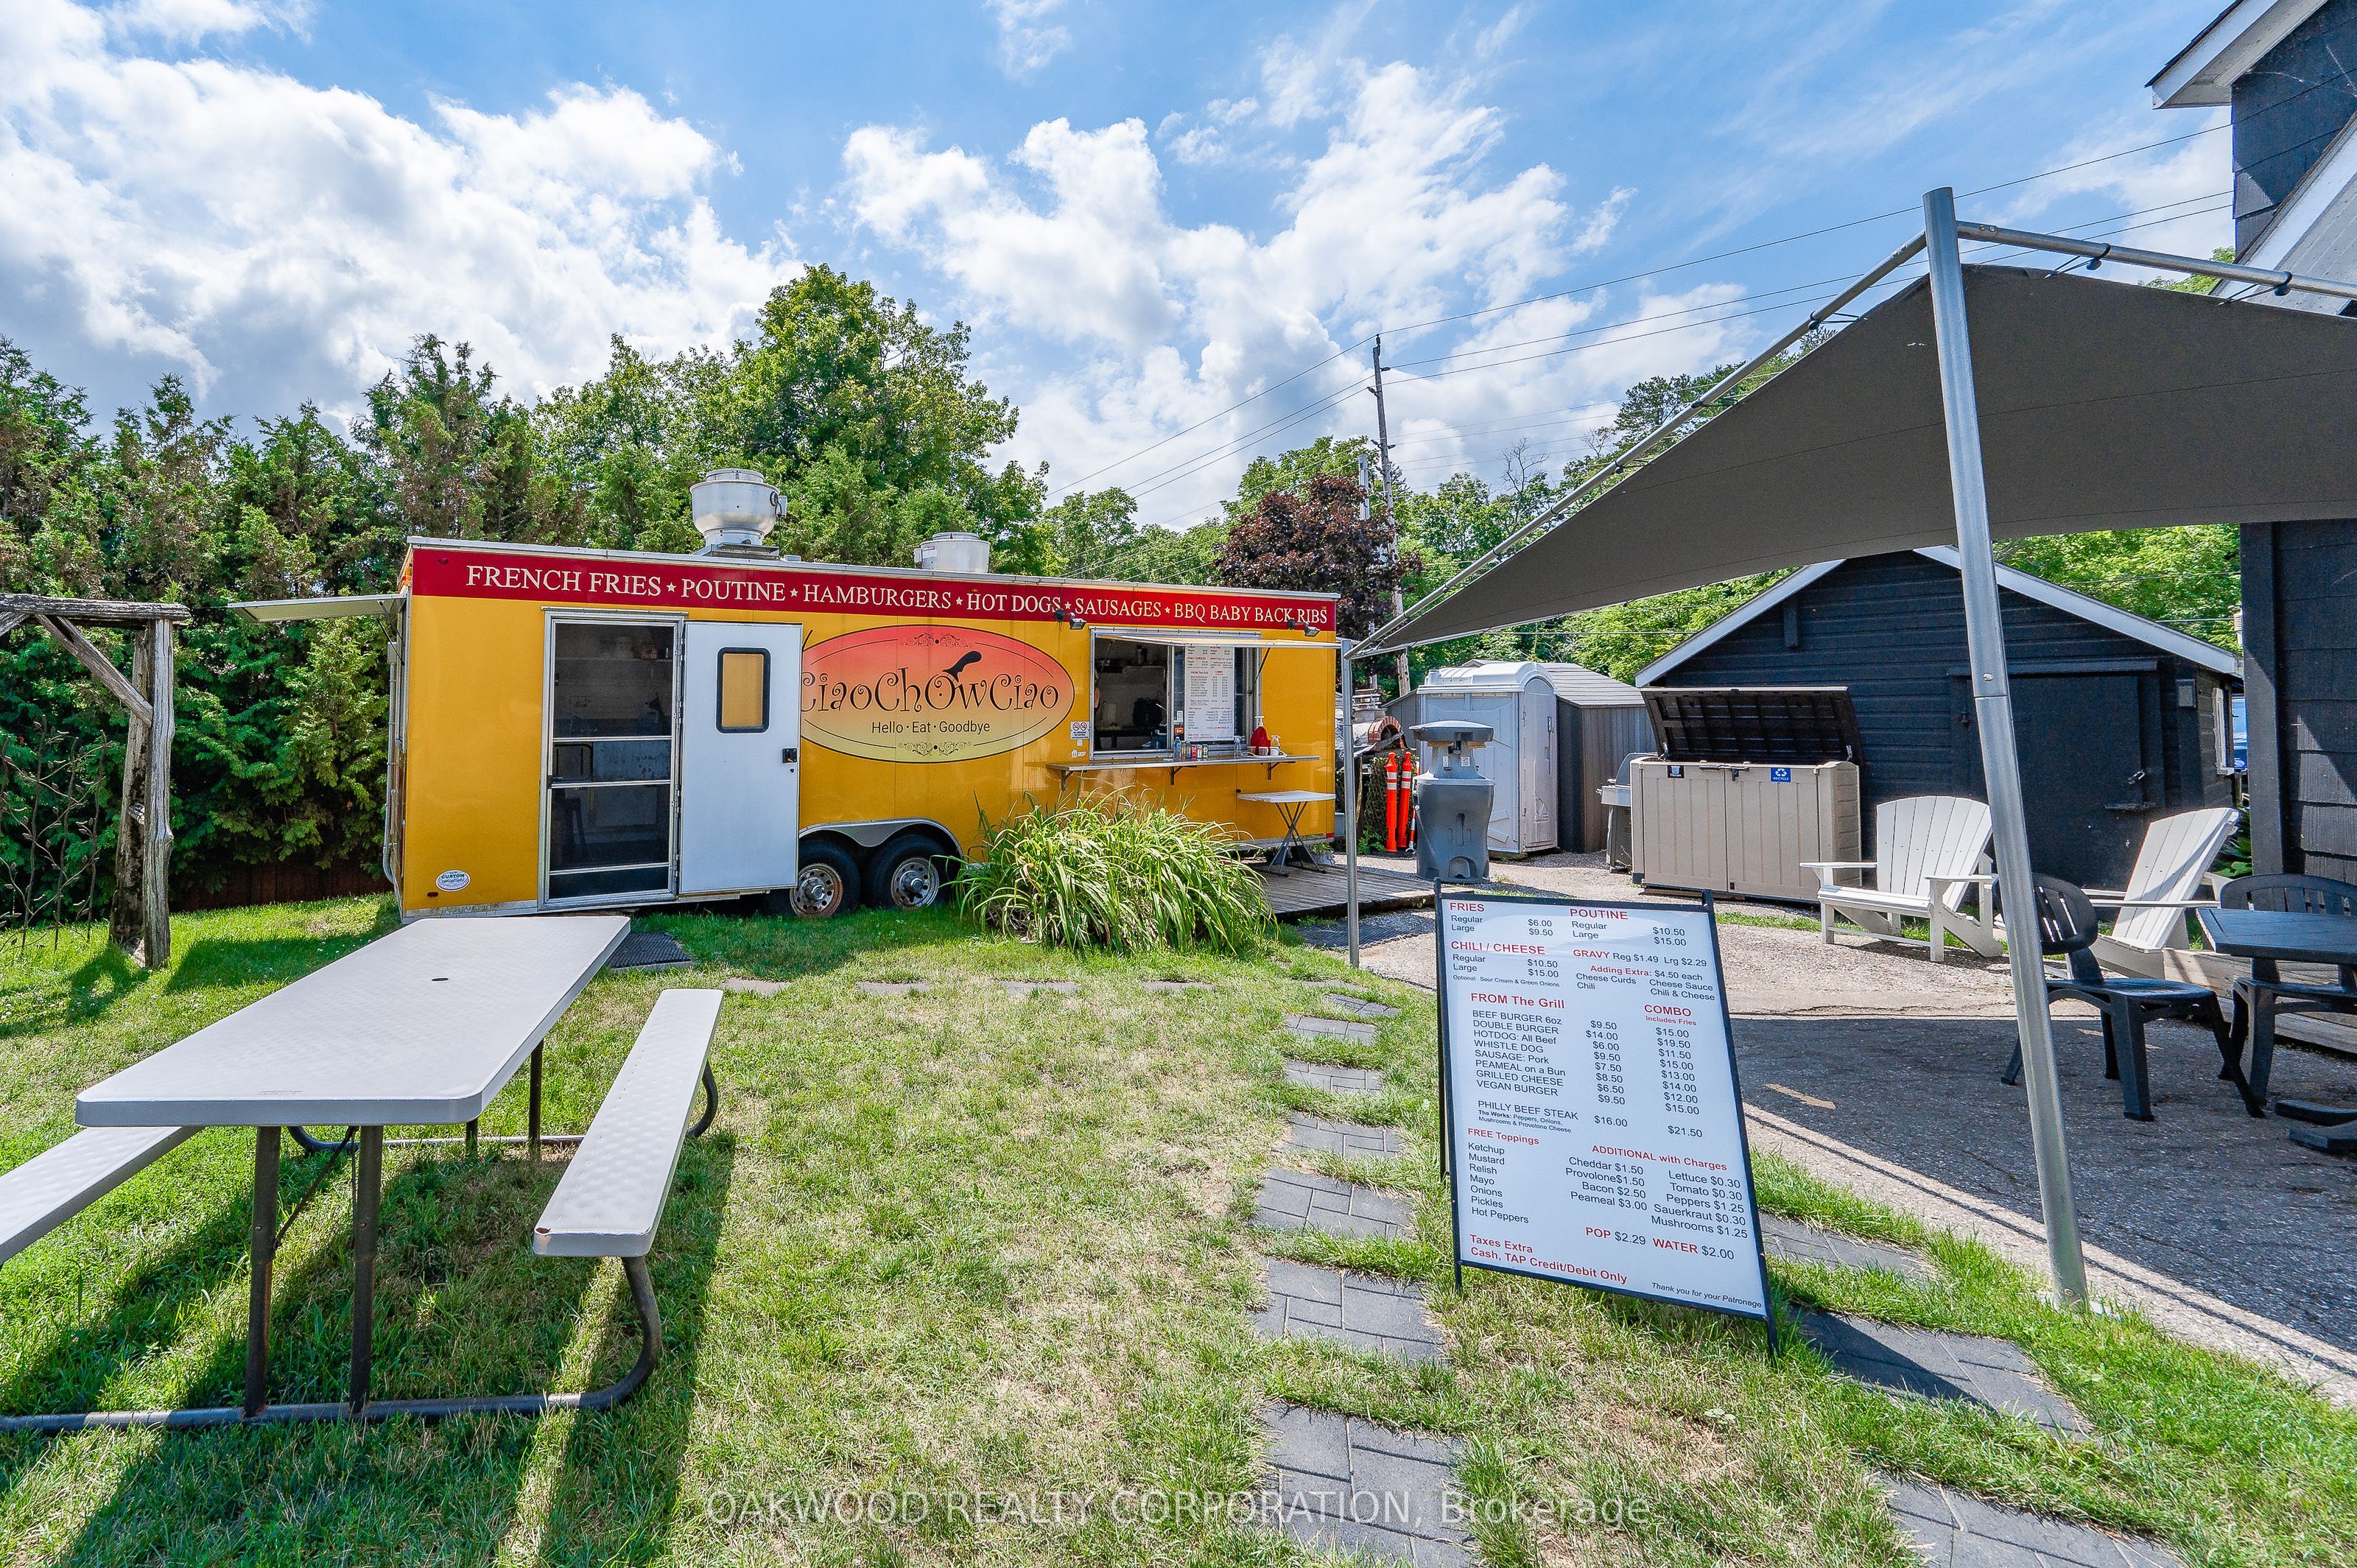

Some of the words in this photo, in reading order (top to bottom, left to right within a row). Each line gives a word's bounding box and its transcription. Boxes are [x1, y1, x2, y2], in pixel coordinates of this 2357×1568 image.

[466, 566, 582, 591] FRENCH
[589, 573, 661, 597] FRIES
[681, 579, 785, 601] POUTINE
[804, 584, 951, 608] HAMBURGERS
[967, 593, 1007, 611] HOT
[1011, 595, 1061, 613] DOGS
[1075, 598, 1162, 617] SAUSAGES
[1174, 603, 1206, 623] BBQ
[1210, 605, 1251, 621] BABY
[1254, 607, 1295, 622] BACK
[1297, 608, 1327, 624] RIBS
[871, 721, 904, 734] Hello
[912, 722, 932, 734] Eat
[939, 720, 991, 736] Goodbye
[1450, 902, 1485, 913] FRIES
[1570, 908, 1629, 920] POUTINE
[1450, 915, 1483, 924] Regular
[1528, 918, 1553, 927] $6.00
[1571, 921, 1608, 930] Regular
[1652, 927, 1685, 936] $10.50
[1451, 924, 1475, 933] Large
[1528, 928, 1553, 936] $9.50
[1573, 930, 1599, 941] Large
[1654, 936, 1687, 946] $15.00
[1451, 941, 1483, 951] CHILI
[1493, 943, 1545, 955] CHEESE
[1453, 954, 1486, 963] Regular
[1527, 958, 1558, 968] $10.50
[1573, 949, 1610, 959] GRAVY
[1612, 952, 1631, 963] Reg
[1633, 954, 1659, 963] $1.49
[1664, 956, 1679, 966] Lrg
[1681, 957, 1707, 967] $2.29
[1453, 963, 1478, 973] Large
[1528, 968, 1559, 978] $15.00
[1576, 972, 1609, 982] Cheese
[1610, 975, 1637, 985] Curds
[1590, 965, 1623, 976] Adding
[1625, 968, 1652, 977] Extra:
[1654, 969, 1679, 979] $4.50
[1576, 982, 1595, 990] Chili
[1649, 978, 1683, 988] Cheese
[1685, 982, 1713, 991] Sauce
[1471, 993, 1508, 1004] FROM
[1511, 996, 1534, 1007] The
[1538, 998, 1564, 1009] Grill
[1650, 988, 1670, 996] Chili
[1681, 991, 1715, 1001] Cheese
[1644, 1004, 1692, 1017] COMBO
[1472, 1010, 1497, 1019] BEEF
[1500, 1012, 1543, 1023] BURGER
[1545, 1016, 1562, 1025] 6oz
[1590, 1020, 1617, 1030] $9.50
[1655, 1027, 1690, 1038] $15.00
[1645, 1015, 1676, 1024] Includes
[1472, 1019, 1514, 1030] DOUBLE
[1515, 1023, 1559, 1035] BURGER
[1585, 1030, 1618, 1041] $14.00
[1657, 1037, 1691, 1049] $19.50
[1473, 1029, 1520, 1041] HOTDOG:
[1521, 1034, 1533, 1042] All
[1535, 1035, 1557, 1044] Beef
[1592, 1040, 1620, 1051] $6.00
[1658, 1048, 1692, 1060] $11.50
[1473, 1039, 1518, 1051] WHISTLE
[1520, 1044, 1544, 1053] DOG
[1593, 1051, 1620, 1062] $9.50
[1659, 1058, 1694, 1071] $15.00
[1475, 1049, 1525, 1062] SAUSAGE:
[1528, 1055, 1550, 1064] Pork
[1595, 1061, 1622, 1072] $7.50
[1661, 1069, 1696, 1082] $13.00
[1475, 1059, 1522, 1072] PEAMEAL
[1547, 1066, 1566, 1077] Bun
[1595, 1072, 1623, 1083] $8.50
[1662, 1080, 1697, 1093] $14.00
[1476, 1069, 1519, 1081] GRILLED
[1521, 1075, 1564, 1087] CHEESE
[1597, 1083, 1624, 1094] $6.50
[1663, 1091, 1699, 1104] $12.00
[1476, 1079, 1511, 1091] VEGAN
[1514, 1083, 1559, 1097] BURGER
[1598, 1094, 1626, 1105] $9.50
[1665, 1103, 1700, 1115] $15.00
[1478, 1100, 1511, 1111] PHILLY
[1514, 1104, 1541, 1115] BEEF
[1544, 1108, 1579, 1120] STEAK
[1594, 1115, 1628, 1128] $16.00
[1668, 1125, 1703, 1138] $21.50
[1490, 1111, 1512, 1119] Works:
[1478, 1116, 1511, 1125] Mushrooms
[1518, 1121, 1548, 1130] Provolone
[1548, 1125, 1572, 1133] Cheese
[1468, 1128, 1494, 1139] FREE
[1495, 1131, 1539, 1146] Toppings
[1468, 1142, 1505, 1156] Ketchup
[1469, 1152, 1505, 1165] Mustard
[1569, 1156, 1612, 1170] Cheddar
[1615, 1162, 1644, 1175] $1.50
[1592, 1145, 1657, 1161] ADDITIONAL
[1659, 1155, 1681, 1164] with
[1684, 1157, 1727, 1171] Charges
[1469, 1163, 1497, 1175] Relish
[1469, 1173, 1495, 1186] Mayo
[1668, 1170, 1707, 1184] Lettuce
[1710, 1175, 1740, 1189] $0.30
[1470, 1184, 1503, 1198] Onions
[1581, 1181, 1615, 1195] Bacon
[1617, 1186, 1646, 1199] $2.50
[1669, 1181, 1710, 1196] Tomato
[1712, 1188, 1743, 1201] $0.30
[1471, 1195, 1503, 1209] Pickles
[1570, 1191, 1615, 1206] Peameal
[1618, 1198, 1648, 1211] $3.00
[1666, 1193, 1711, 1209] Peppers
[1713, 1200, 1744, 1214] $1.25
[1472, 1206, 1488, 1217] Hot
[1490, 1209, 1529, 1224] Peppers
[1654, 1203, 1713, 1221] Sauerkraut
[1715, 1212, 1746, 1226] $0.30
[1651, 1214, 1714, 1234] Mushrooms
[1716, 1225, 1748, 1239] $1.25
[1469, 1234, 1501, 1248] Taxes
[1504, 1240, 1533, 1254] Extra
[1585, 1226, 1611, 1239] POP
[1615, 1231, 1646, 1245] $2.29
[1652, 1237, 1699, 1254] WATER
[1701, 1245, 1735, 1260] $2.00
[1471, 1246, 1501, 1262] Cash,
[1504, 1252, 1527, 1264] TAP
[1529, 1257, 1598, 1278] Credit/Debit
[1600, 1270, 1627, 1285] Only
[1651, 1282, 1675, 1293] Thank
[1691, 1289, 1702, 1297] for
[1704, 1293, 1721, 1301] your
[1722, 1295, 1762, 1309] Patronage
